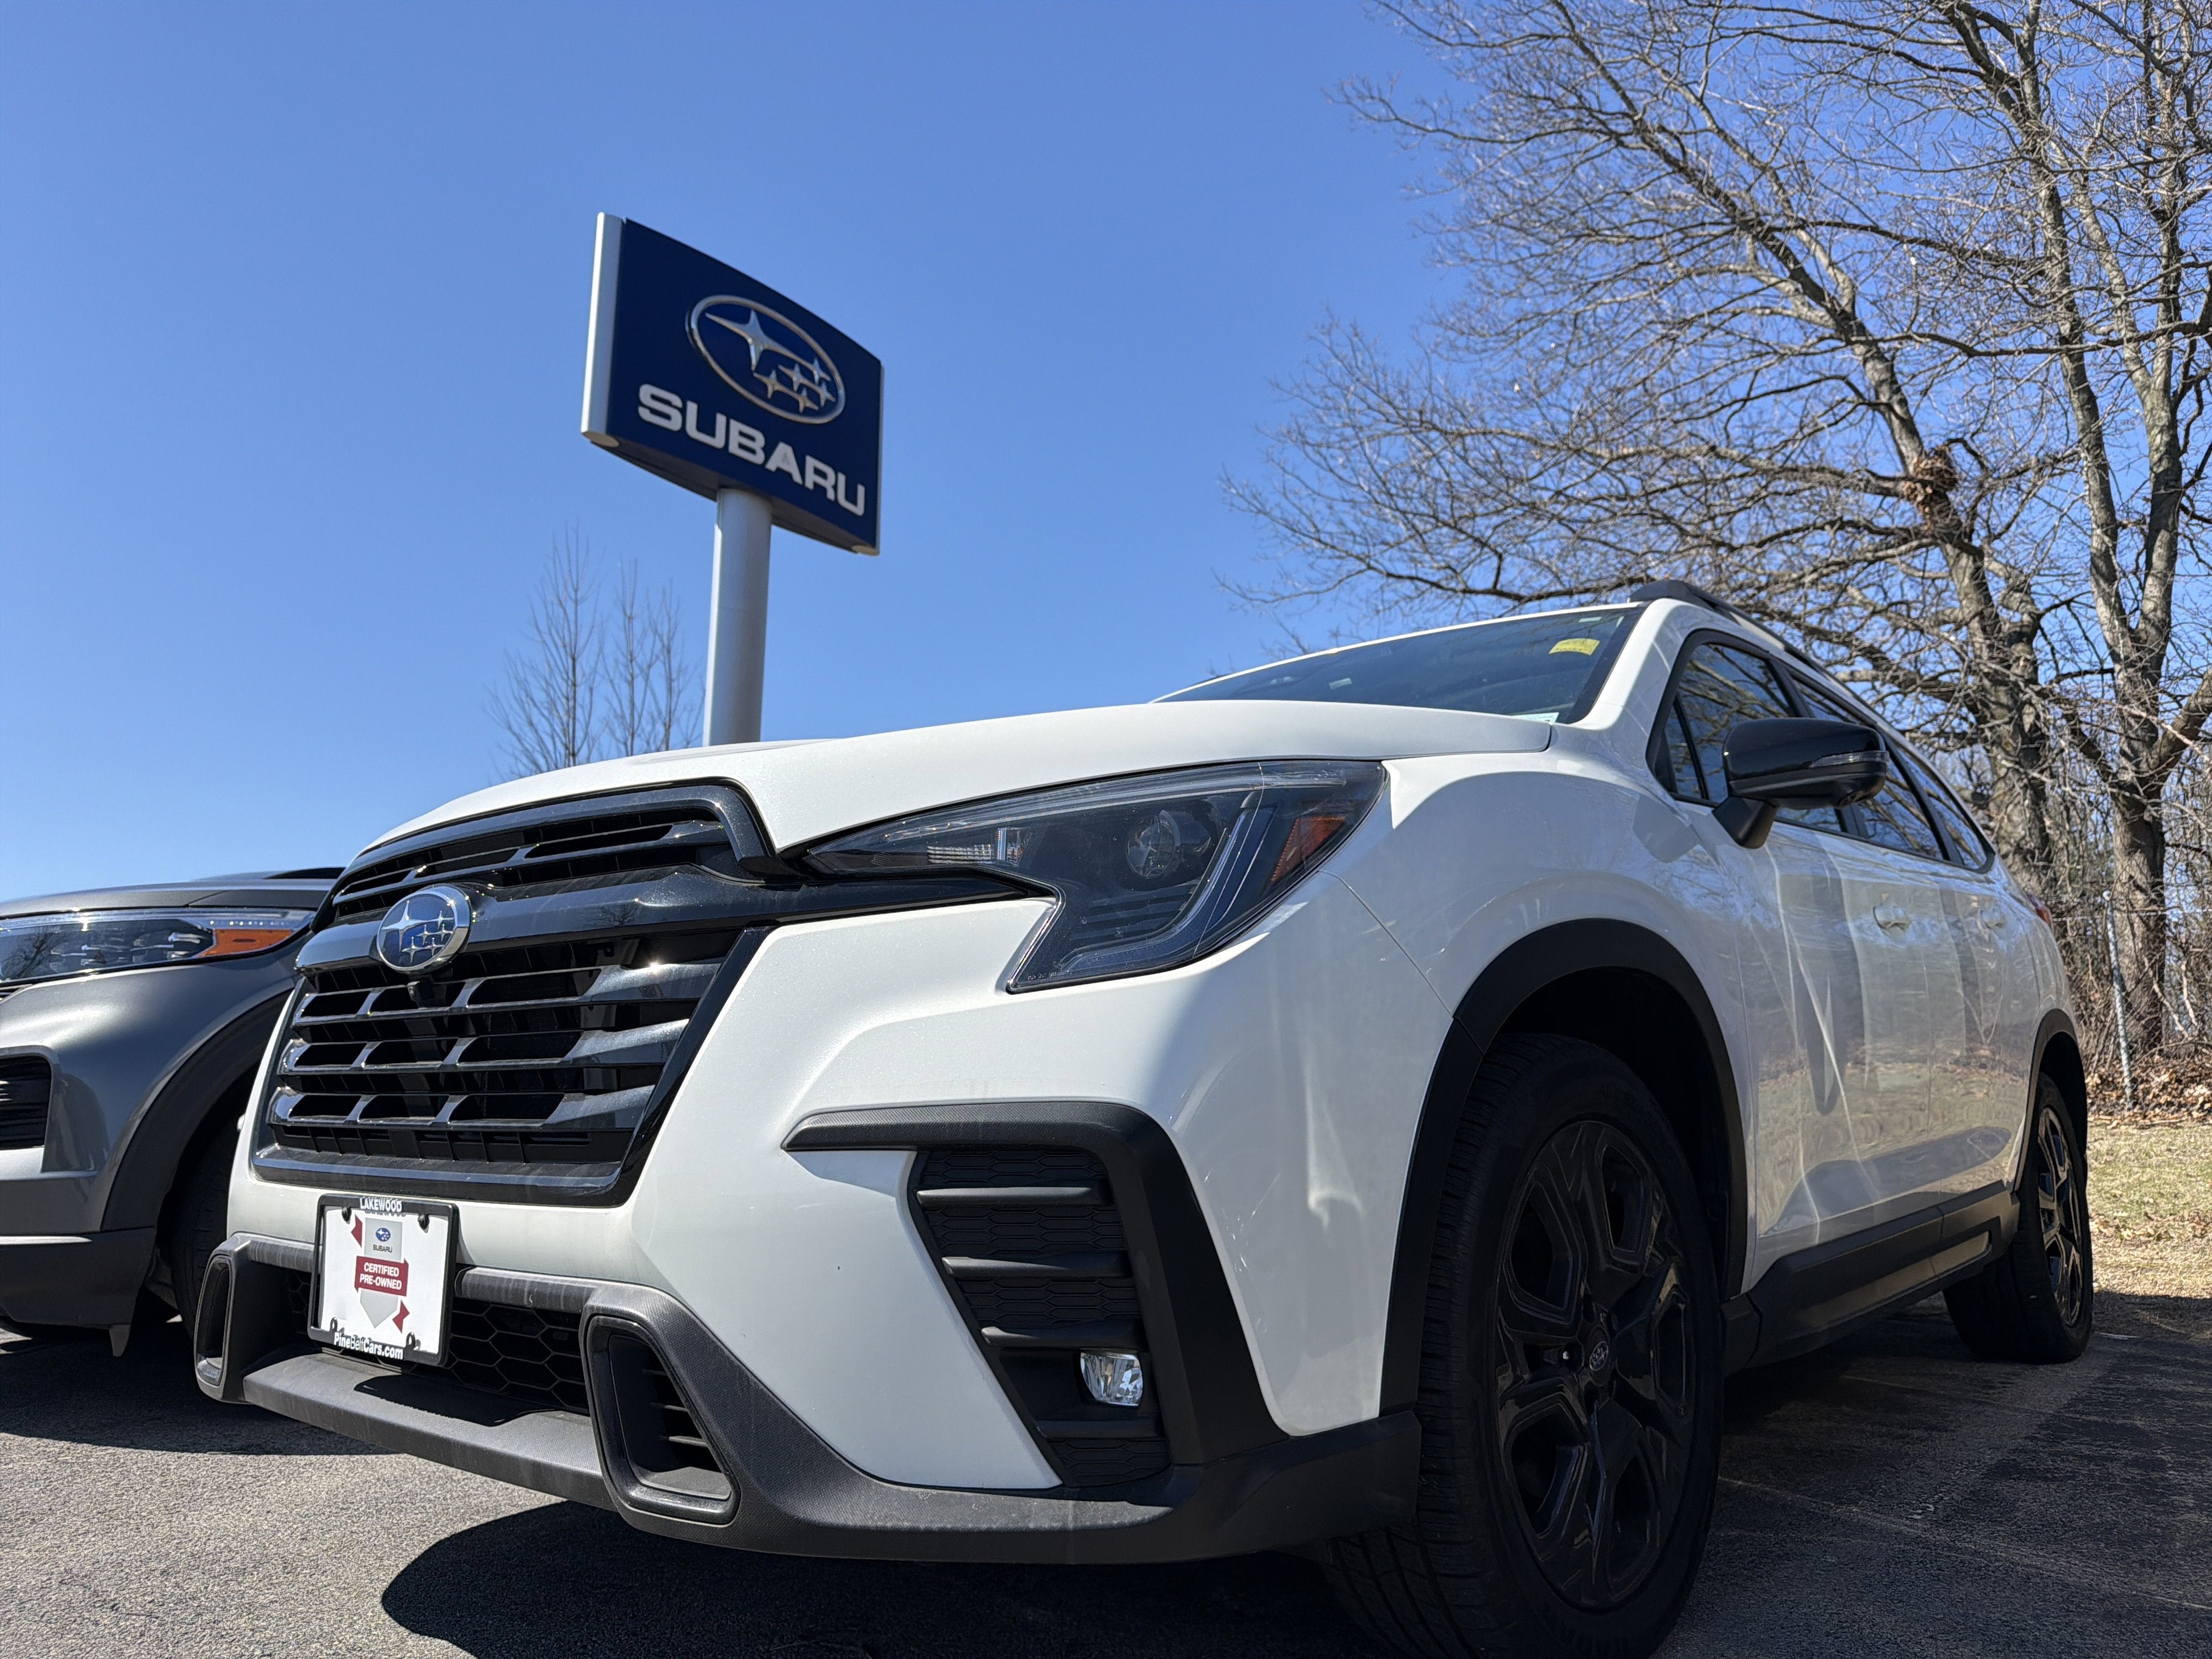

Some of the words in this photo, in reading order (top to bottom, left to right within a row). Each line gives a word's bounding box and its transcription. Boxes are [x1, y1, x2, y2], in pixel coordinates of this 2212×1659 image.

[637, 383, 865, 517] SUBARU
[359, 1197, 402, 1212] LAKEWOOD
[373, 1244, 392, 1253] SUBARU
[364, 1262, 399, 1277] CERTIFIED
[359, 1273, 402, 1290] PRE-OWNED
[334, 1331, 404, 1360] PineBeltCars.com
